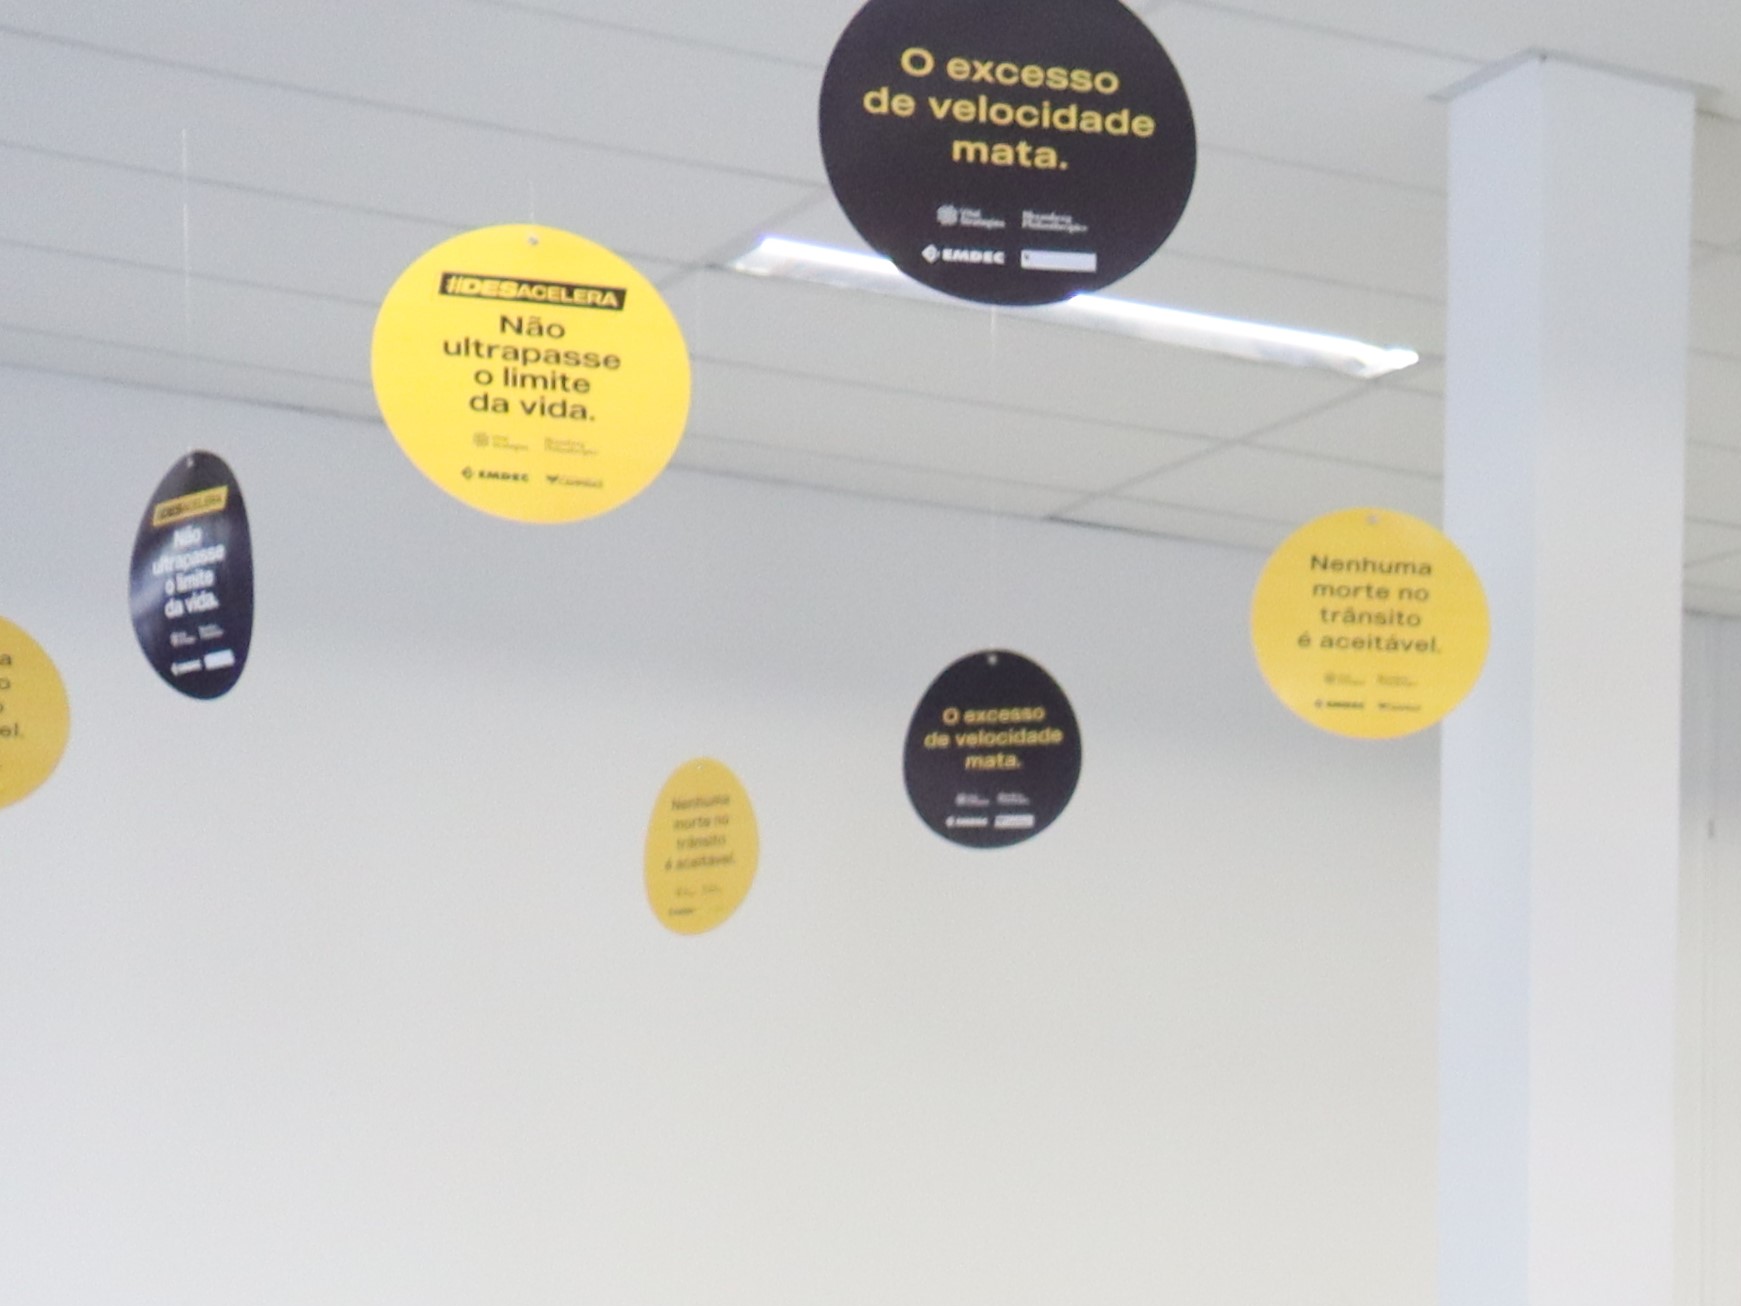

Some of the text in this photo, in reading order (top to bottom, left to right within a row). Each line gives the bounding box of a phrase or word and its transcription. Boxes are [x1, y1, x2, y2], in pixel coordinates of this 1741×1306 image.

[901, 47, 1119, 95] O excesso
[863, 86, 1156, 137] de velocidade
[952, 138, 1069, 170] mata.
[942, 248, 1005, 265] EMDEC
[446, 275, 618, 307] #DESACELERA
[499, 315, 565, 339] Não
[442, 337, 621, 371] ultrapasse
[474, 367, 591, 394] o limite
[469, 393, 596, 422] da vida.
[1310, 555, 1432, 575] Nenhuma
[1312, 583, 1429, 602] morte no
[1320, 607, 1421, 627] trânsito
[1297, 631, 1311, 648] é
[942, 706, 1046, 726] O excesso
[923, 727, 1064, 749] de velocidade
[965, 752, 1022, 770] mata.
